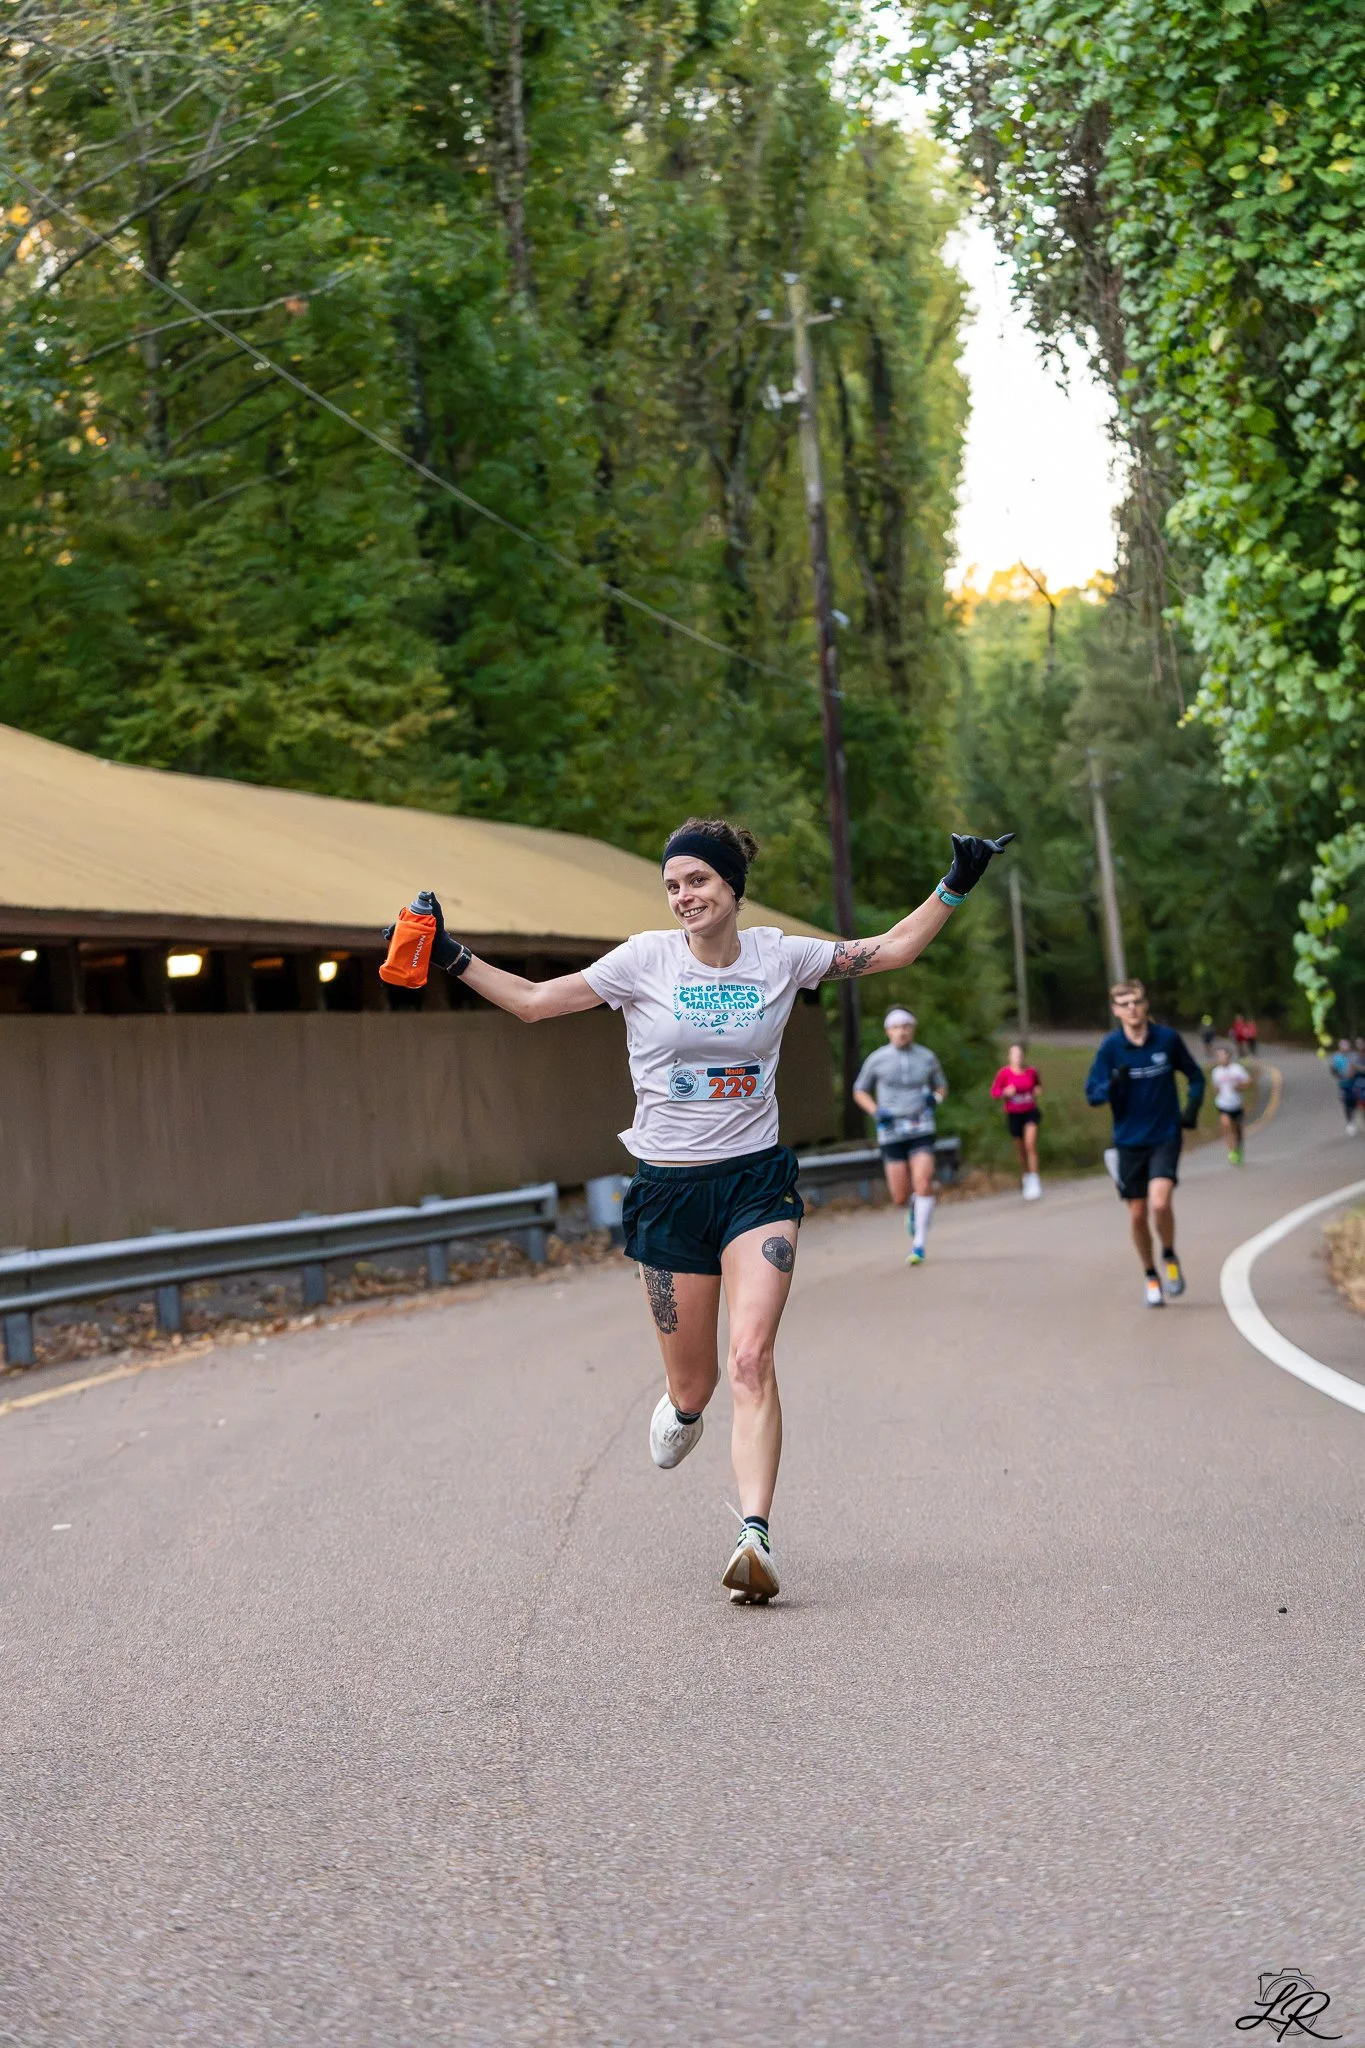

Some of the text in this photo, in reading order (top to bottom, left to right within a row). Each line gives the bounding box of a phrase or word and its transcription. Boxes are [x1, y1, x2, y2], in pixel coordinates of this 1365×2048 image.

[412, 935, 426, 967] NATHAN
[679, 991, 759, 1003] CHICAGO
[709, 1076, 756, 1098] 229
